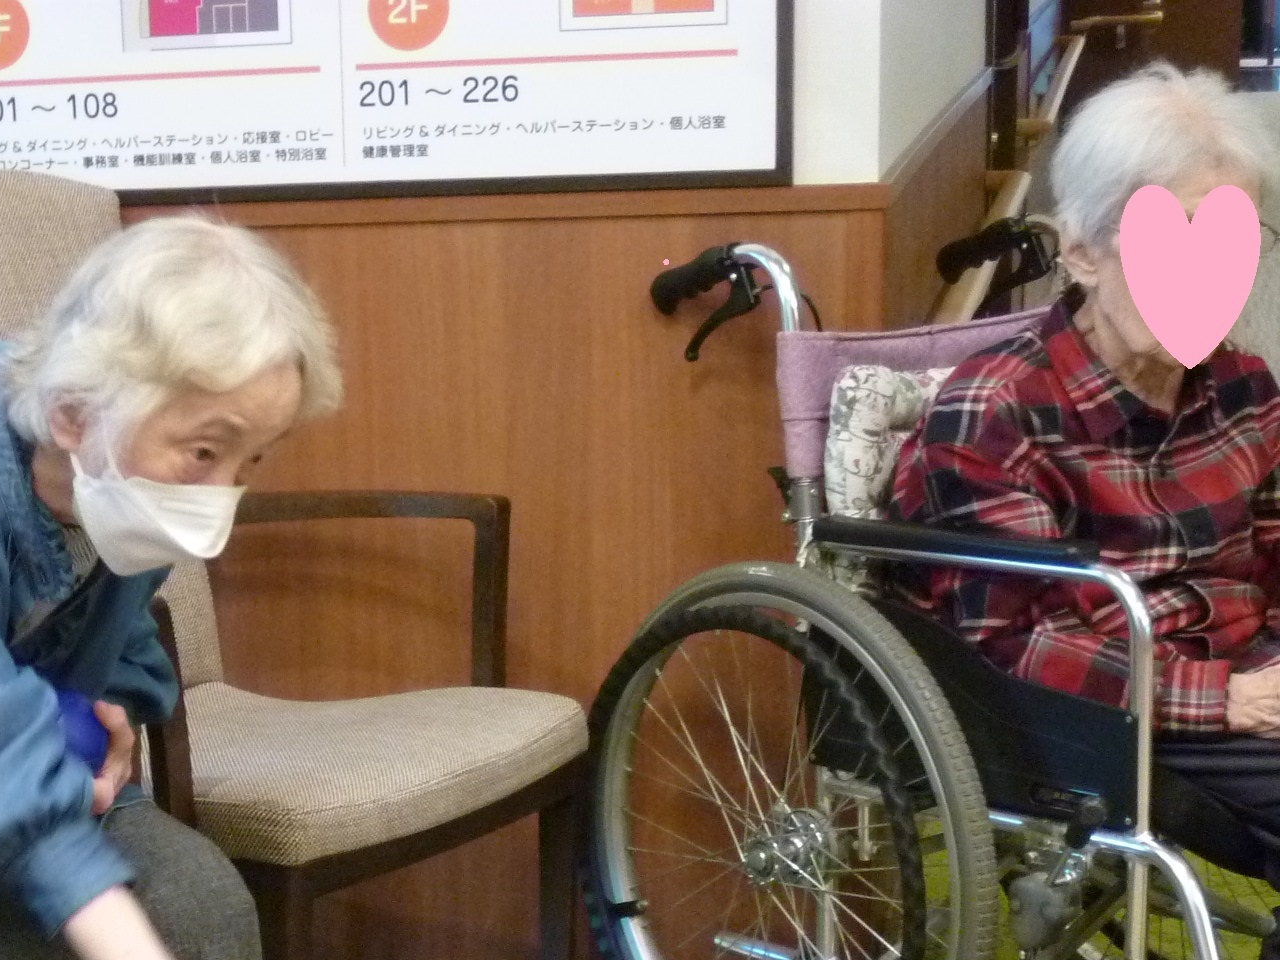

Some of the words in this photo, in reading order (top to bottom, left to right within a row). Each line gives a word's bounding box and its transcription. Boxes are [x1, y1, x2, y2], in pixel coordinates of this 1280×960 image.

[388, 0, 428, 24] 2F
[359, 79, 410, 107] 201
[462, 75, 519, 103] 226
[67, 92, 118, 120] 108
[362, 143, 429, 159] 健康管理室
